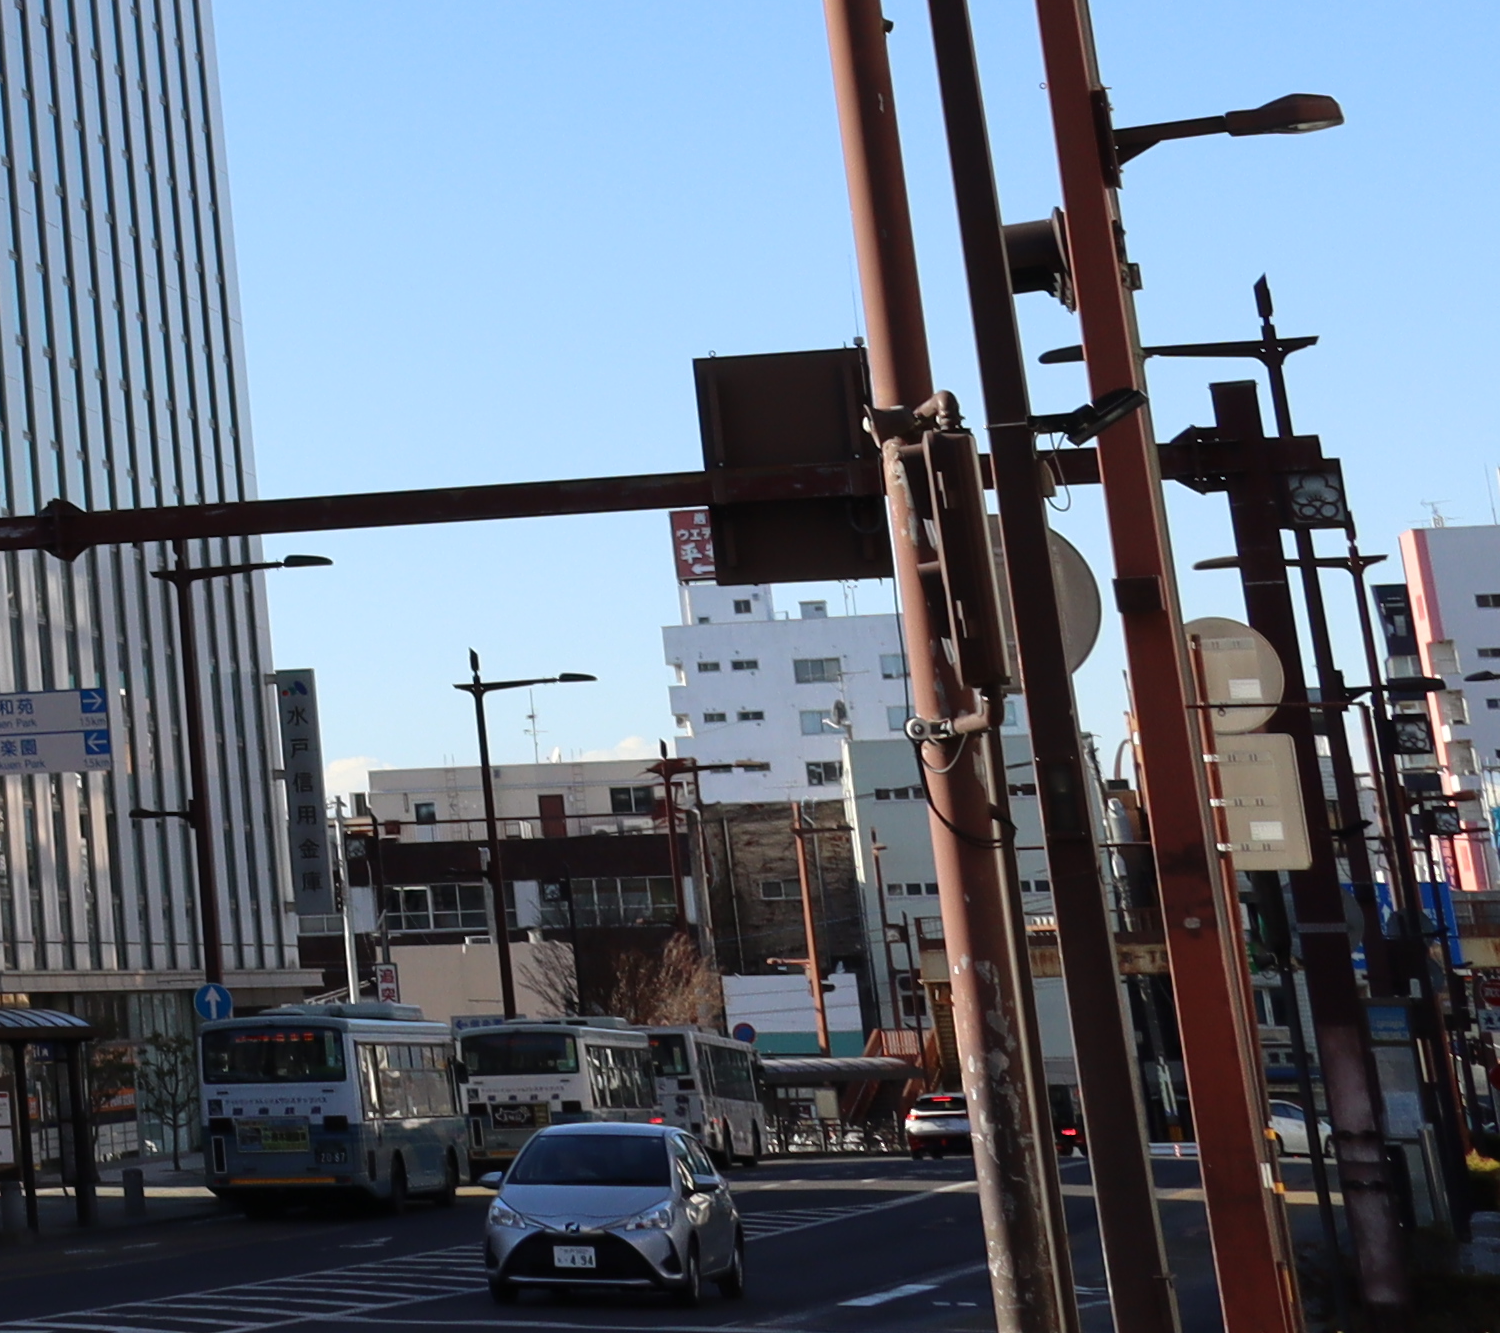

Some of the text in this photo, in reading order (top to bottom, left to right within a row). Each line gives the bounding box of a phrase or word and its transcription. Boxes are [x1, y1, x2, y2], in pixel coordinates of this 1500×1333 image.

[16, 718, 38, 728] Park
[23, 758, 46, 769] Park
[287, 706, 323, 892] 水戸信用金庫
[379, 969, 396, 1002] 追突
